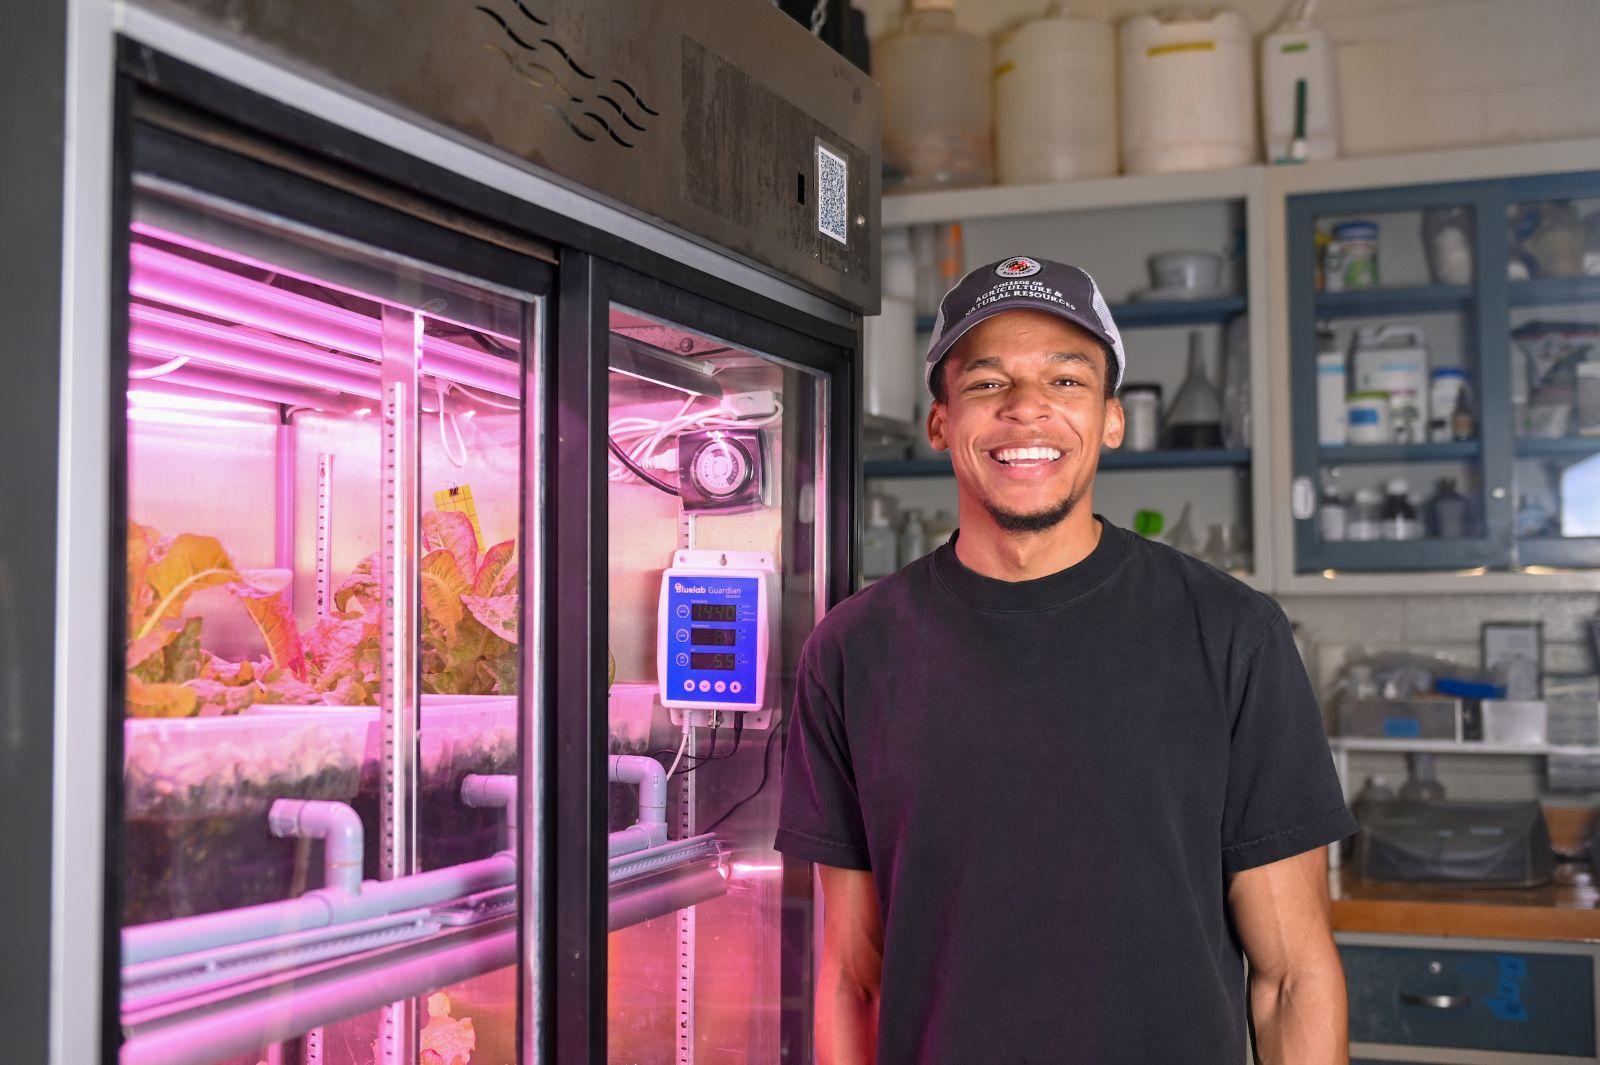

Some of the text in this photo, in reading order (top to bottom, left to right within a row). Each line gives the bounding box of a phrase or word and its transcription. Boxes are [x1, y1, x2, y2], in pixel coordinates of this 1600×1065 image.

[993, 280, 1030, 290] COLLEGE
[975, 284, 1063, 303] AGRICULTURE &
[965, 290, 1077, 318] NATURAL RESOURCES
[675, 583, 742, 595] Bluelab Guardian
